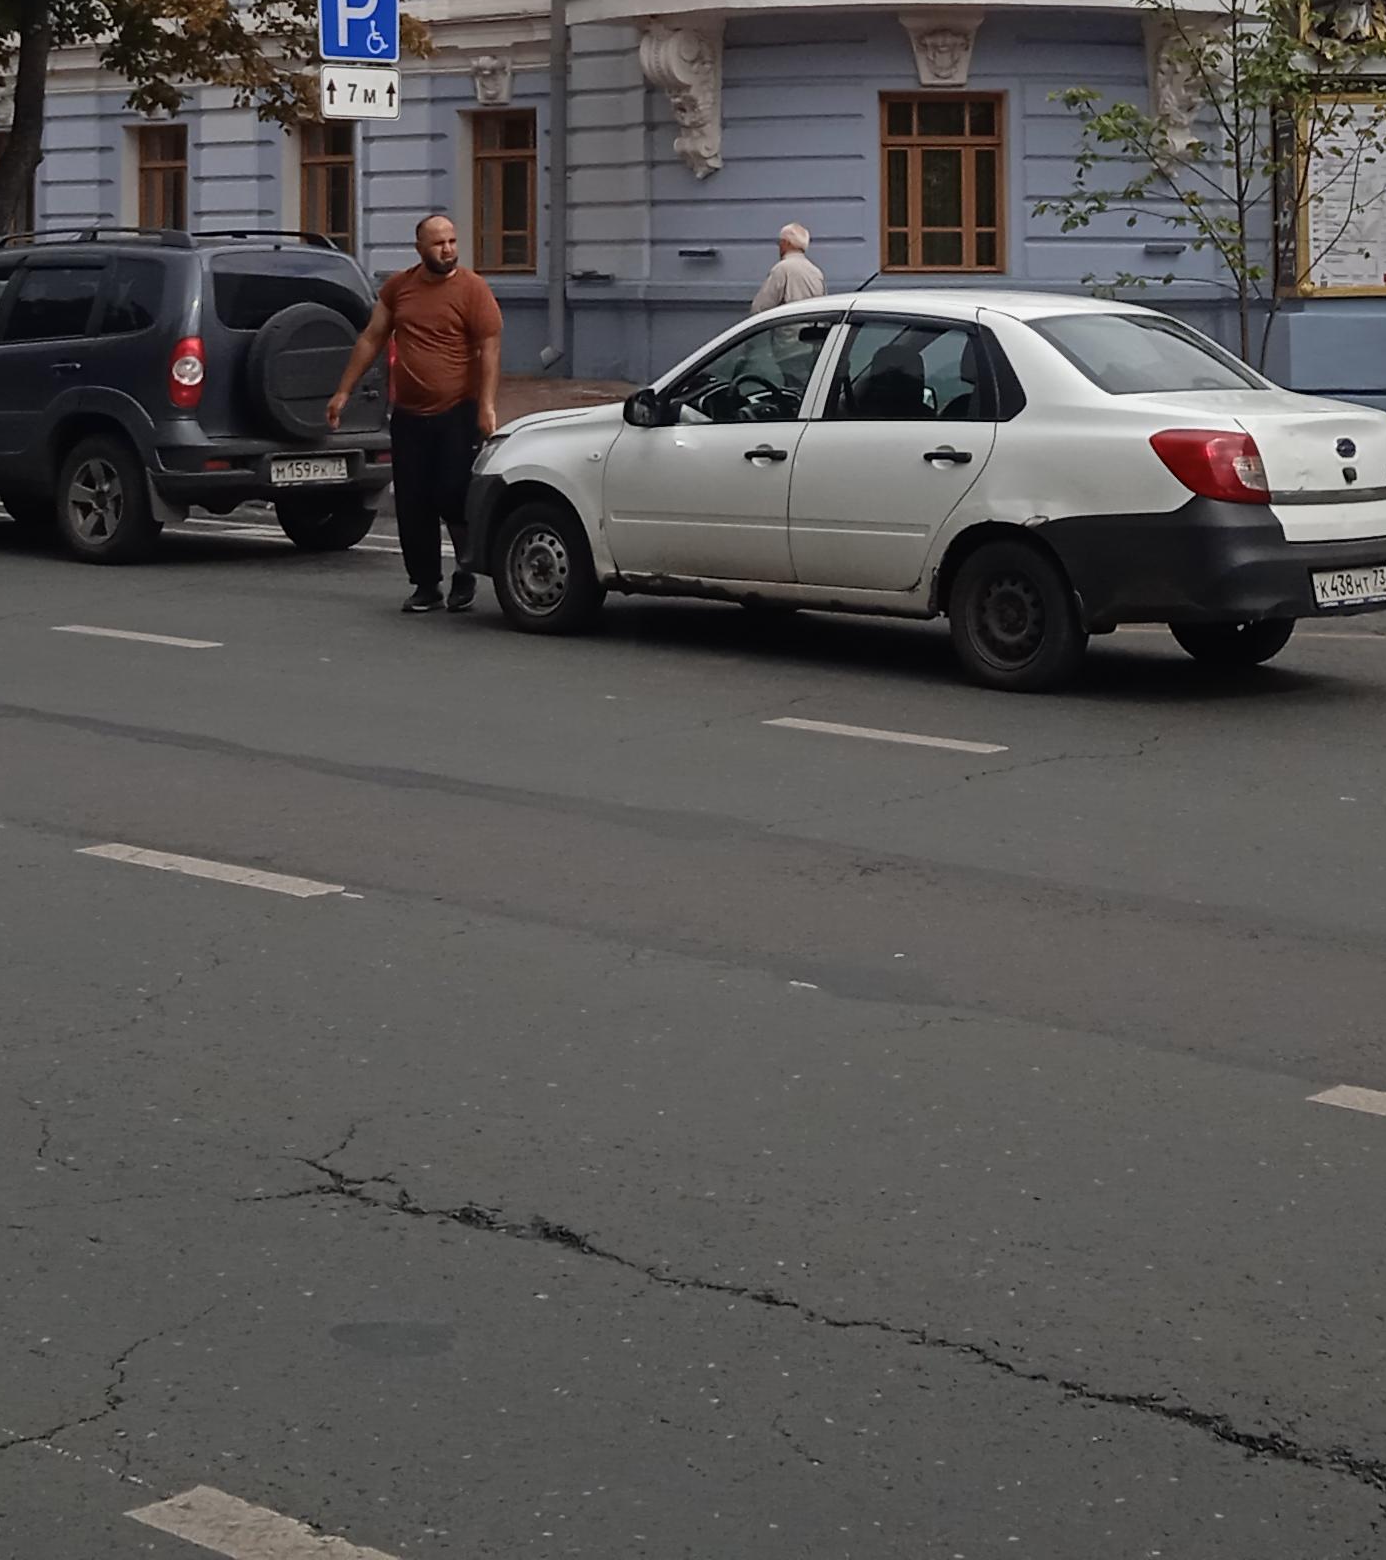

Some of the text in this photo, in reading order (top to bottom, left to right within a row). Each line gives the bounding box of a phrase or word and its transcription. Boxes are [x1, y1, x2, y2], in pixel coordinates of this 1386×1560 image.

[348, 83, 358, 103] 7
[1319, 569, 1386, 599] К438НТ 73
